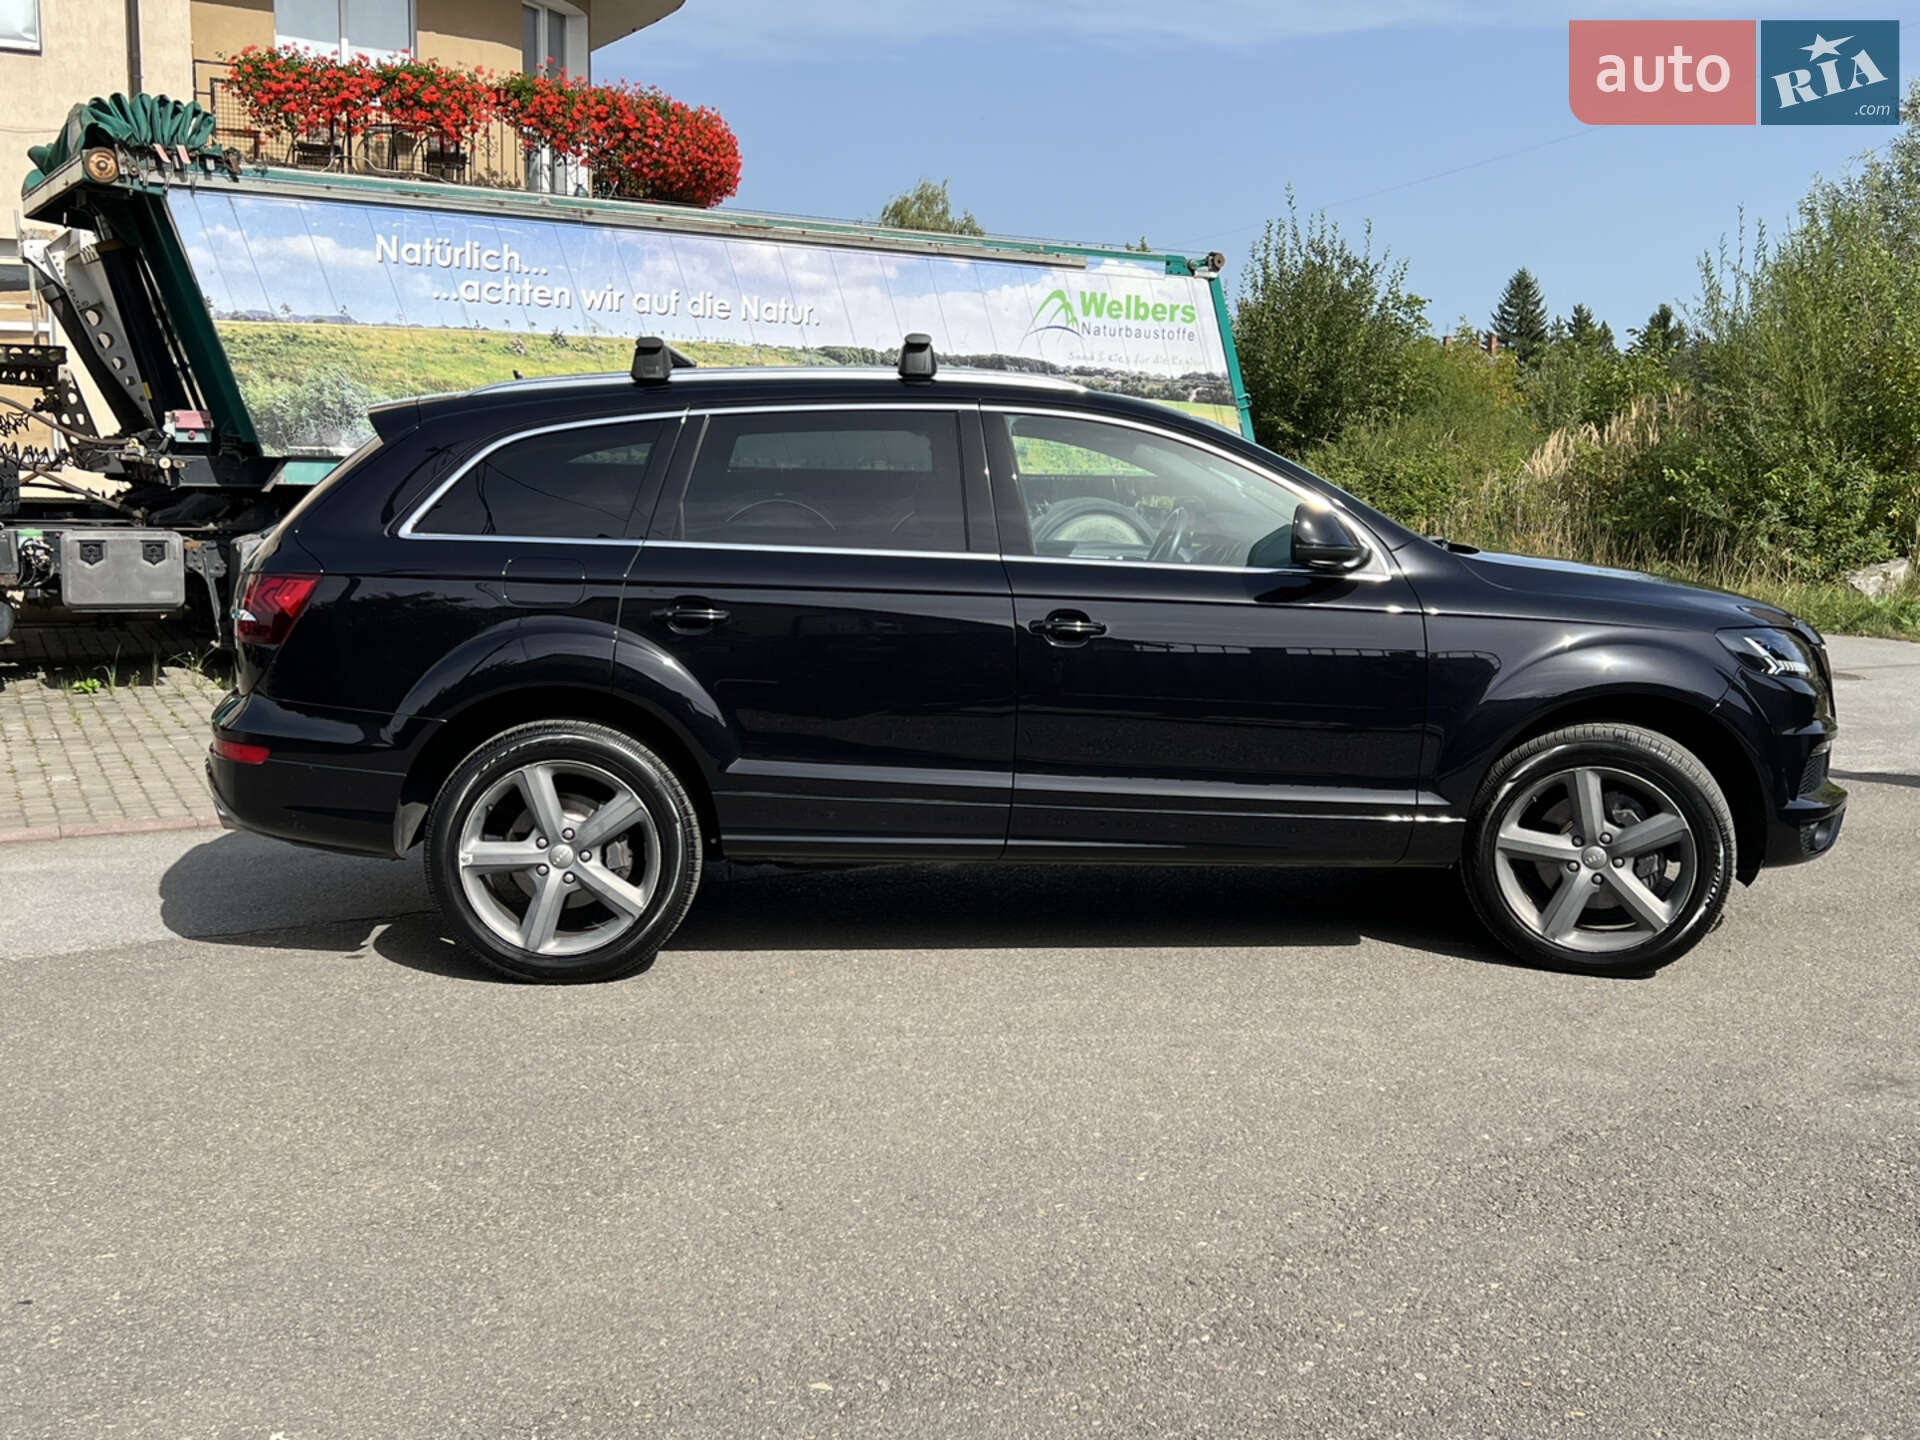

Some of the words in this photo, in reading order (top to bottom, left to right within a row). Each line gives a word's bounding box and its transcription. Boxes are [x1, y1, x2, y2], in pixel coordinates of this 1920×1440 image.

[375, 234, 549, 277] Natürlich...
[432, 276, 572, 309] ...achten
[580, 284, 625, 314] wir
[632, 289, 681, 318] auf
[687, 290, 732, 320] die
[741, 295, 821, 327] Natur.
[1079, 290, 1197, 325] Welbers
[1081, 321, 1196, 342] Naturbaustoffe
